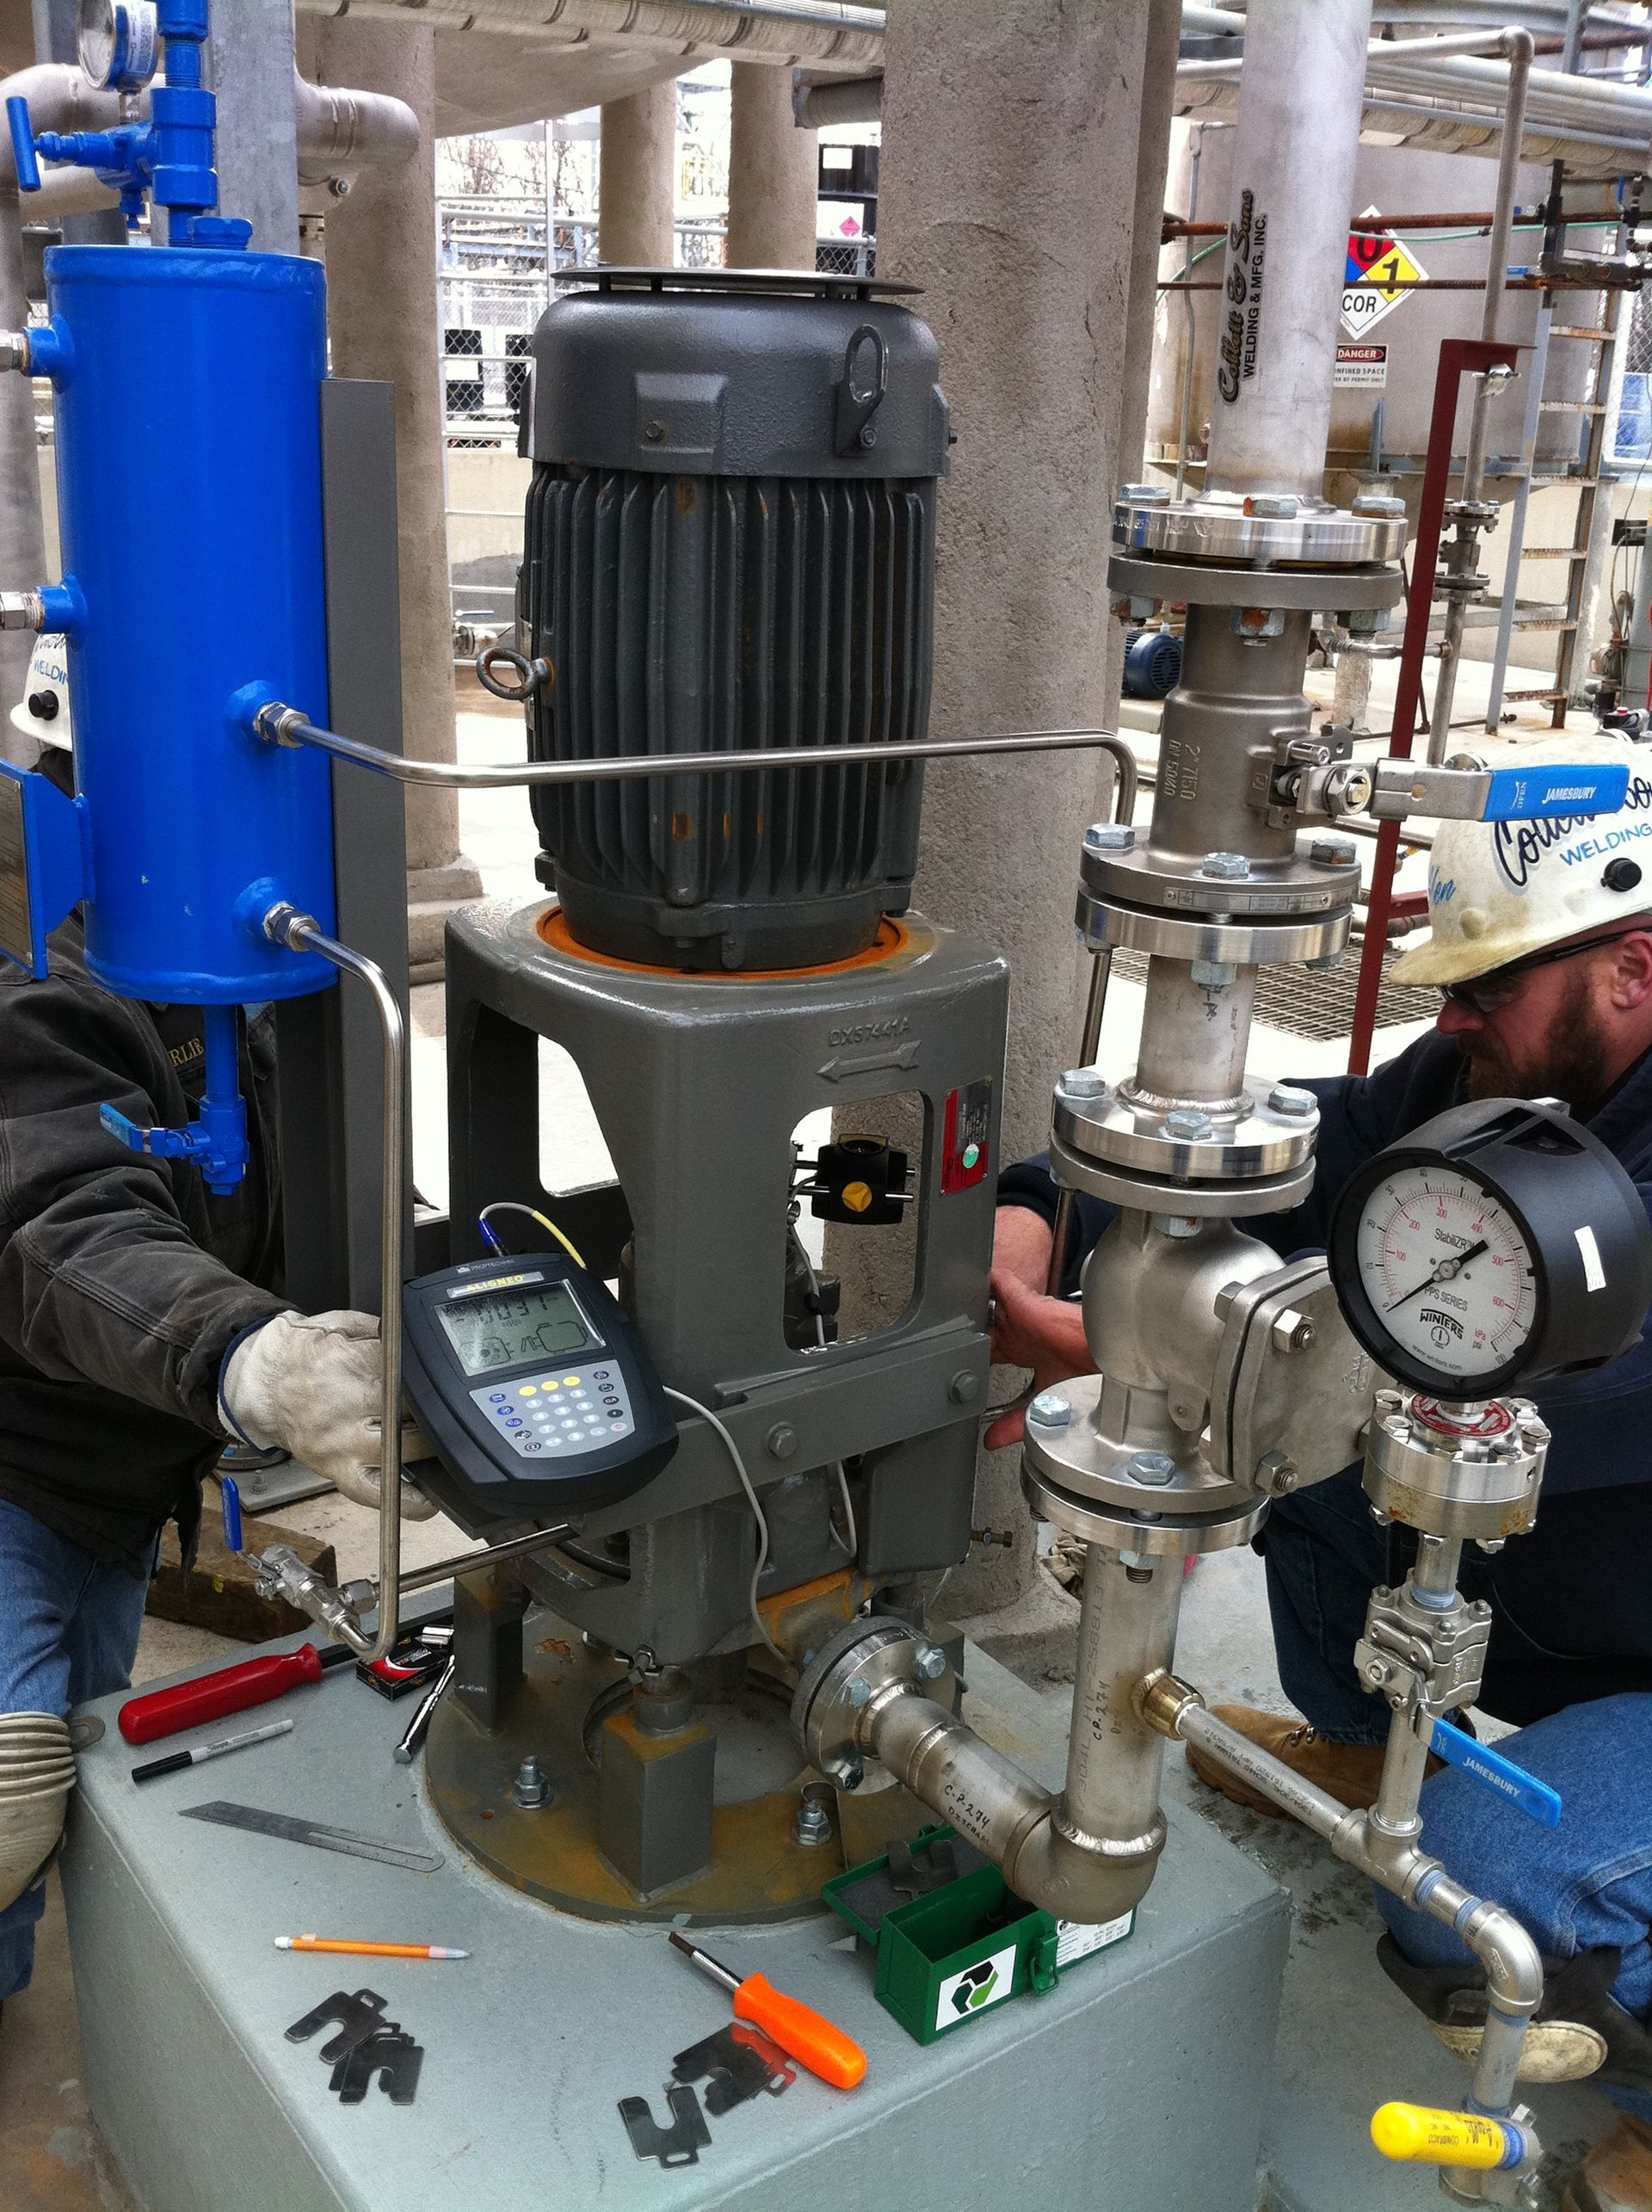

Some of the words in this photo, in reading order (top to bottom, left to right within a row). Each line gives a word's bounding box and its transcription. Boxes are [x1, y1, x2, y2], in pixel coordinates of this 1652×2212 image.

[1230, 188, 1254, 264] Sons
[1254, 214, 1267, 247] INC.
[1254, 250, 1263, 290] MFG.
[1383, 258, 1399, 294] 1
[1251, 293, 1261, 304] &
[1341, 294, 1377, 313] COR
[1243, 305, 1259, 379] WELDING
[1218, 310, 1244, 402] Collett
[1337, 349, 1377, 359] DANGER
[1542, 786, 1596, 804] JAMESBURY
[1559, 823, 1652, 866] WELDING
[1385, 1185, 1395, 1195] 30
[1436, 1207, 1447, 1218] 300
[1366, 1218, 1376, 1229] 20
[1409, 1219, 1421, 1230] 200
[1396, 1251, 1407, 1261] 100
[1492, 1255, 1504, 1266] 500
[1440, 1291, 1468, 1311] SERIES
[1493, 1296, 1504, 1308] 600
[1420, 1311, 1464, 1340] WINTERS
[1463, 1757, 1520, 1798] JAMESBURY
